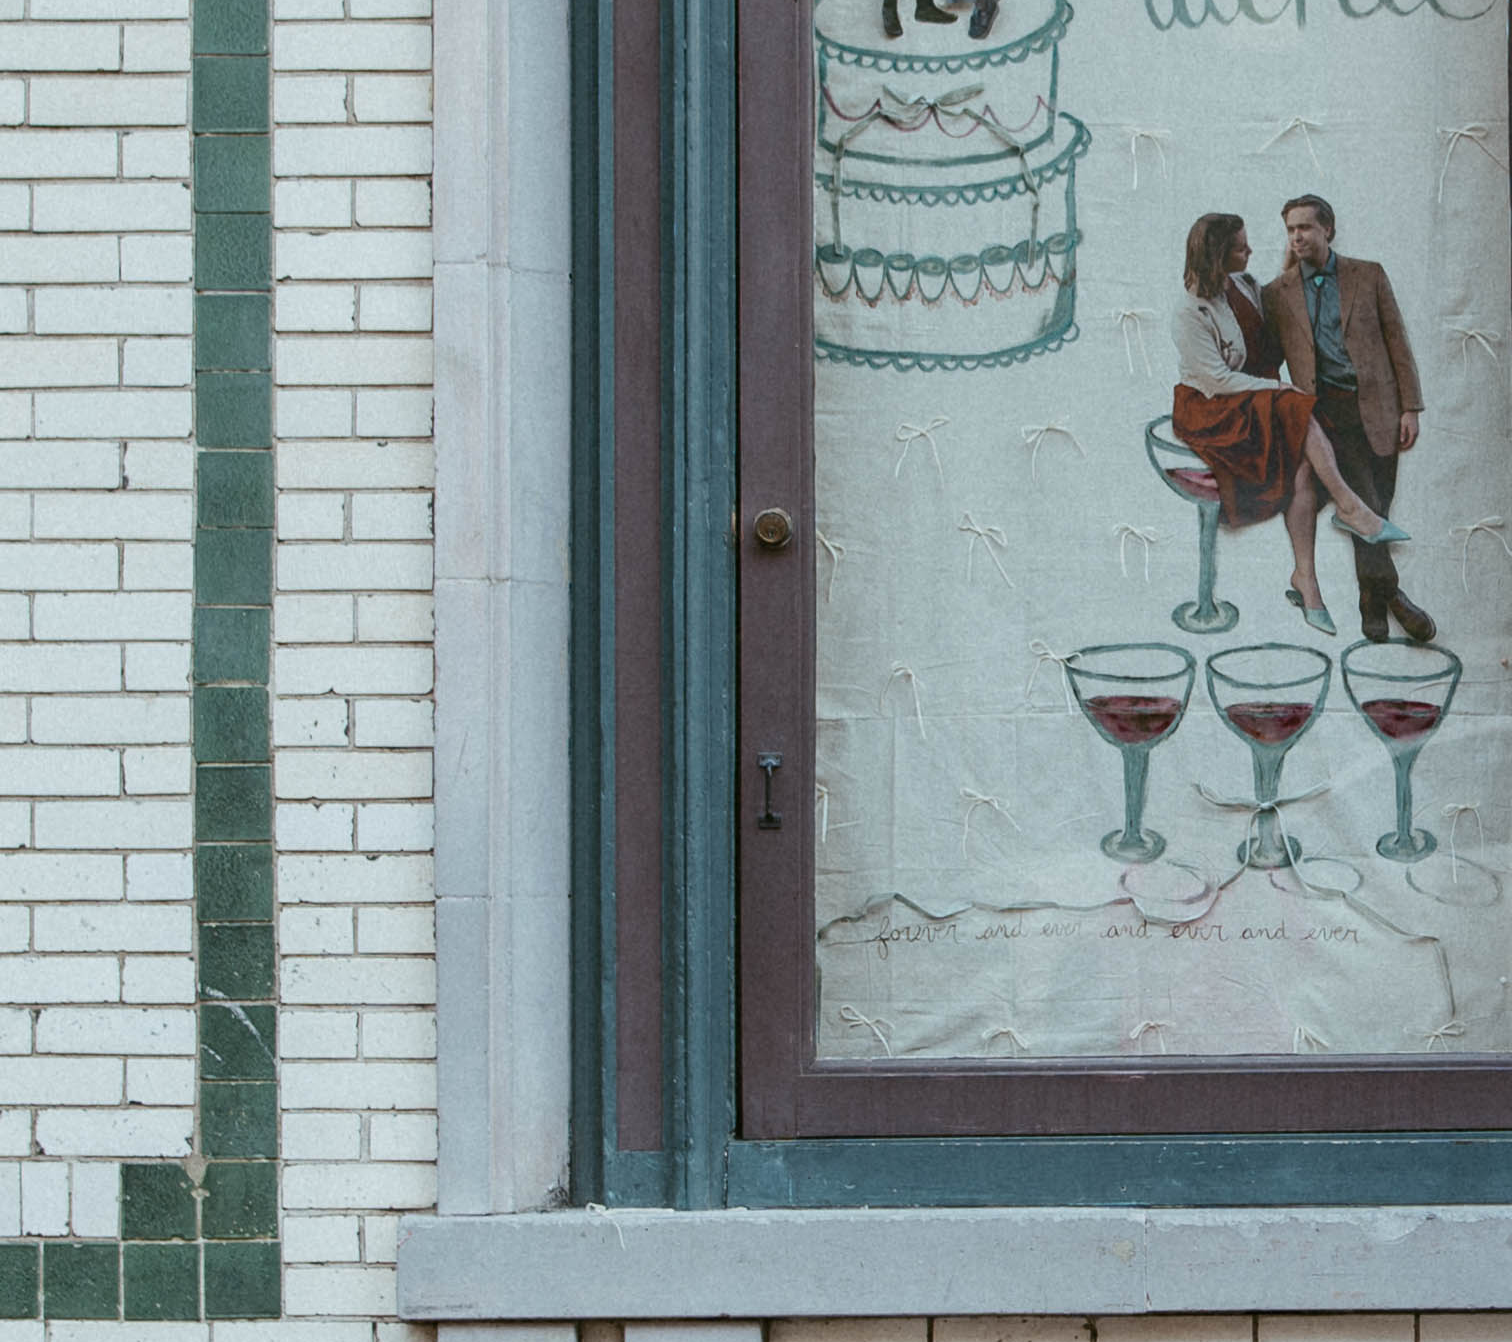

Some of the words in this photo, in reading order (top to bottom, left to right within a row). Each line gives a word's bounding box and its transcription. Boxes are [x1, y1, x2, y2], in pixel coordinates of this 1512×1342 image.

[975, 912, 1028, 940] and
[1099, 918, 1152, 941] and
[1240, 919, 1289, 941] and
[1302, 923, 1363, 944] ever
